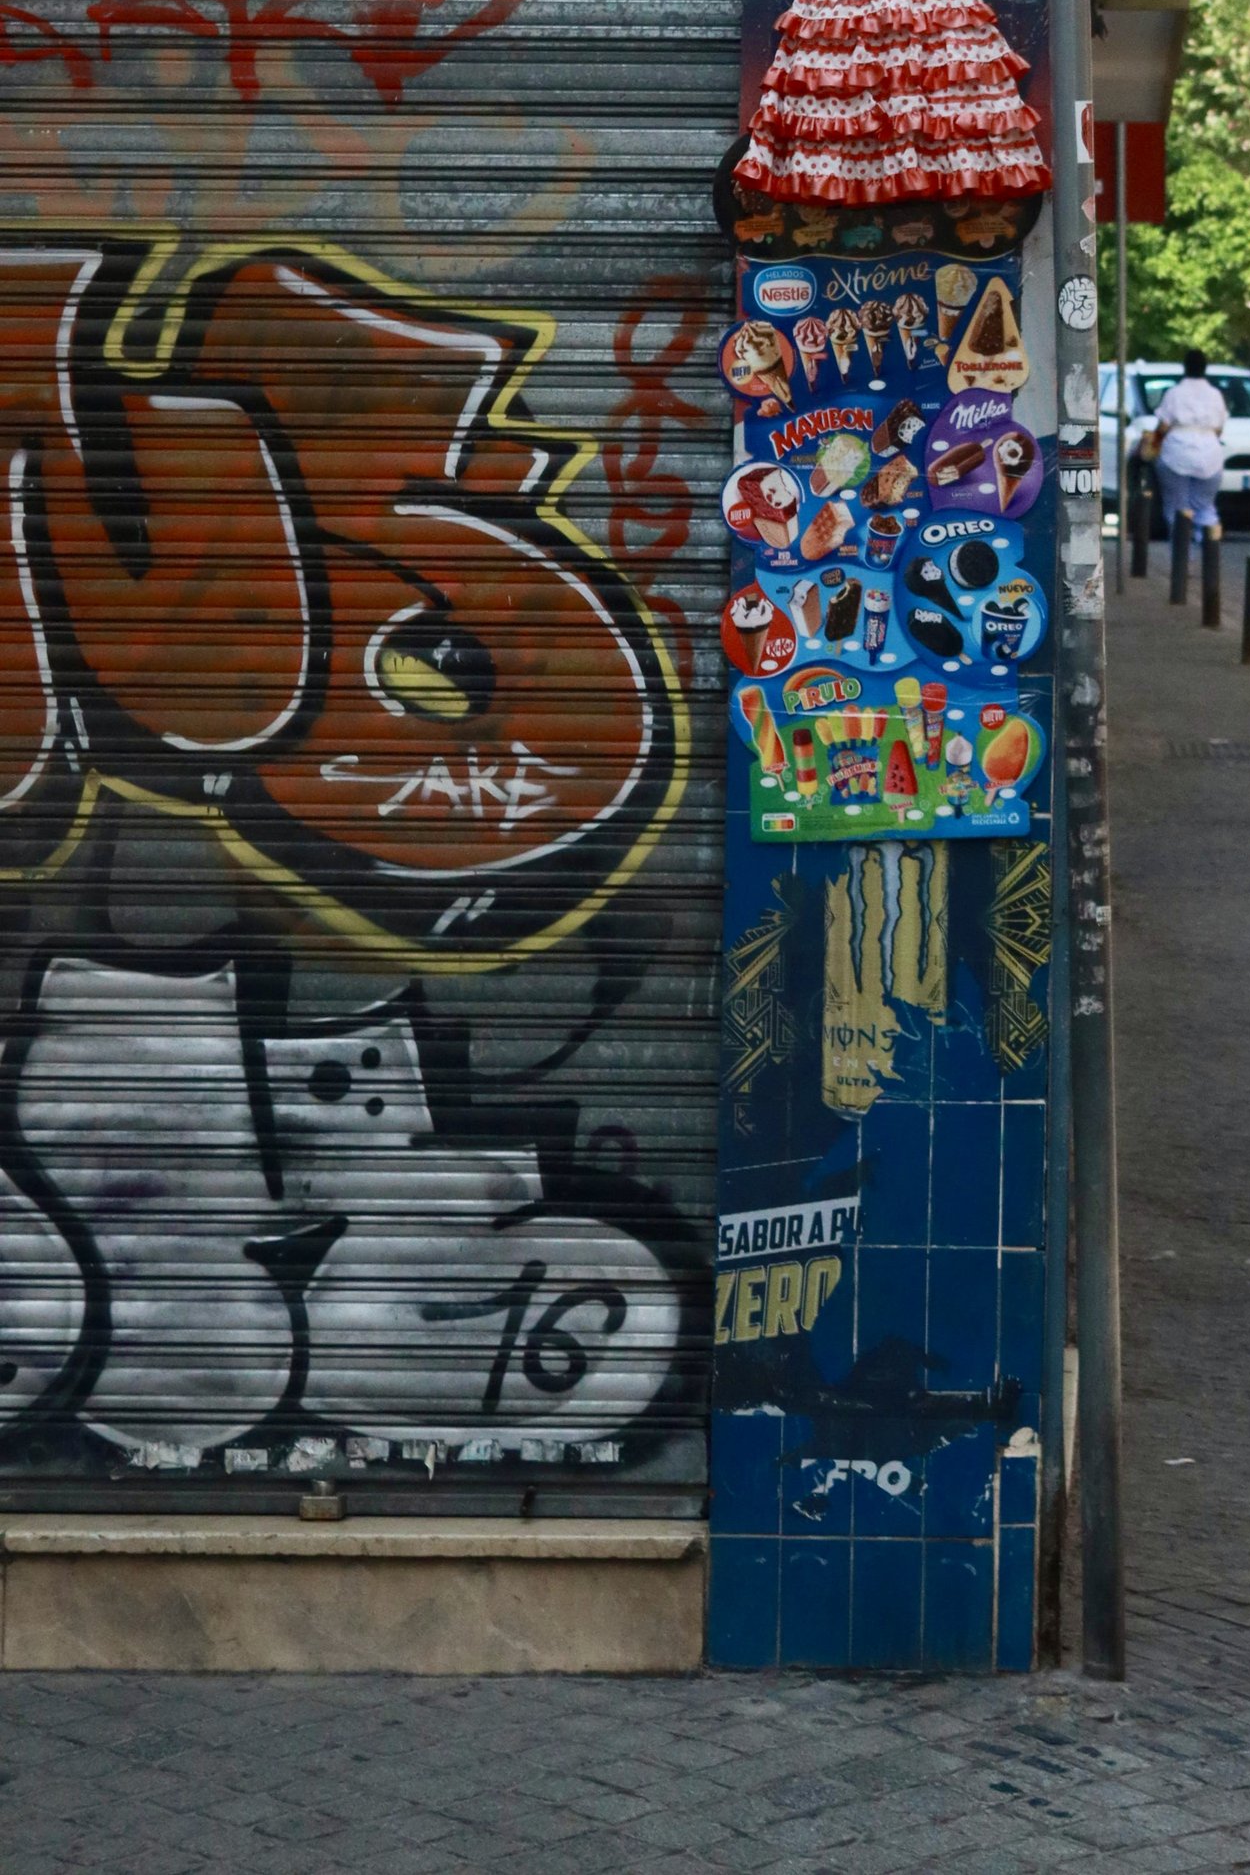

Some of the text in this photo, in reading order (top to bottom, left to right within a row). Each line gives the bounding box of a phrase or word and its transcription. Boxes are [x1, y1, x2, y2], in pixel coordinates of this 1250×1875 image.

[954, 361, 1024, 373] TOBLERONE
[950, 399, 1010, 430] Milka
[769, 407, 874, 460] MAXIBON
[730, 508, 751, 522] NUEVO
[922, 519, 995, 544] OREO
[998, 584, 1034, 594] NUEVO
[985, 621, 1023, 632] OREO
[319, 740, 581, 831] SAKE
[719, 1214, 804, 1257] SABOR
[807, 1210, 825, 1245] A
